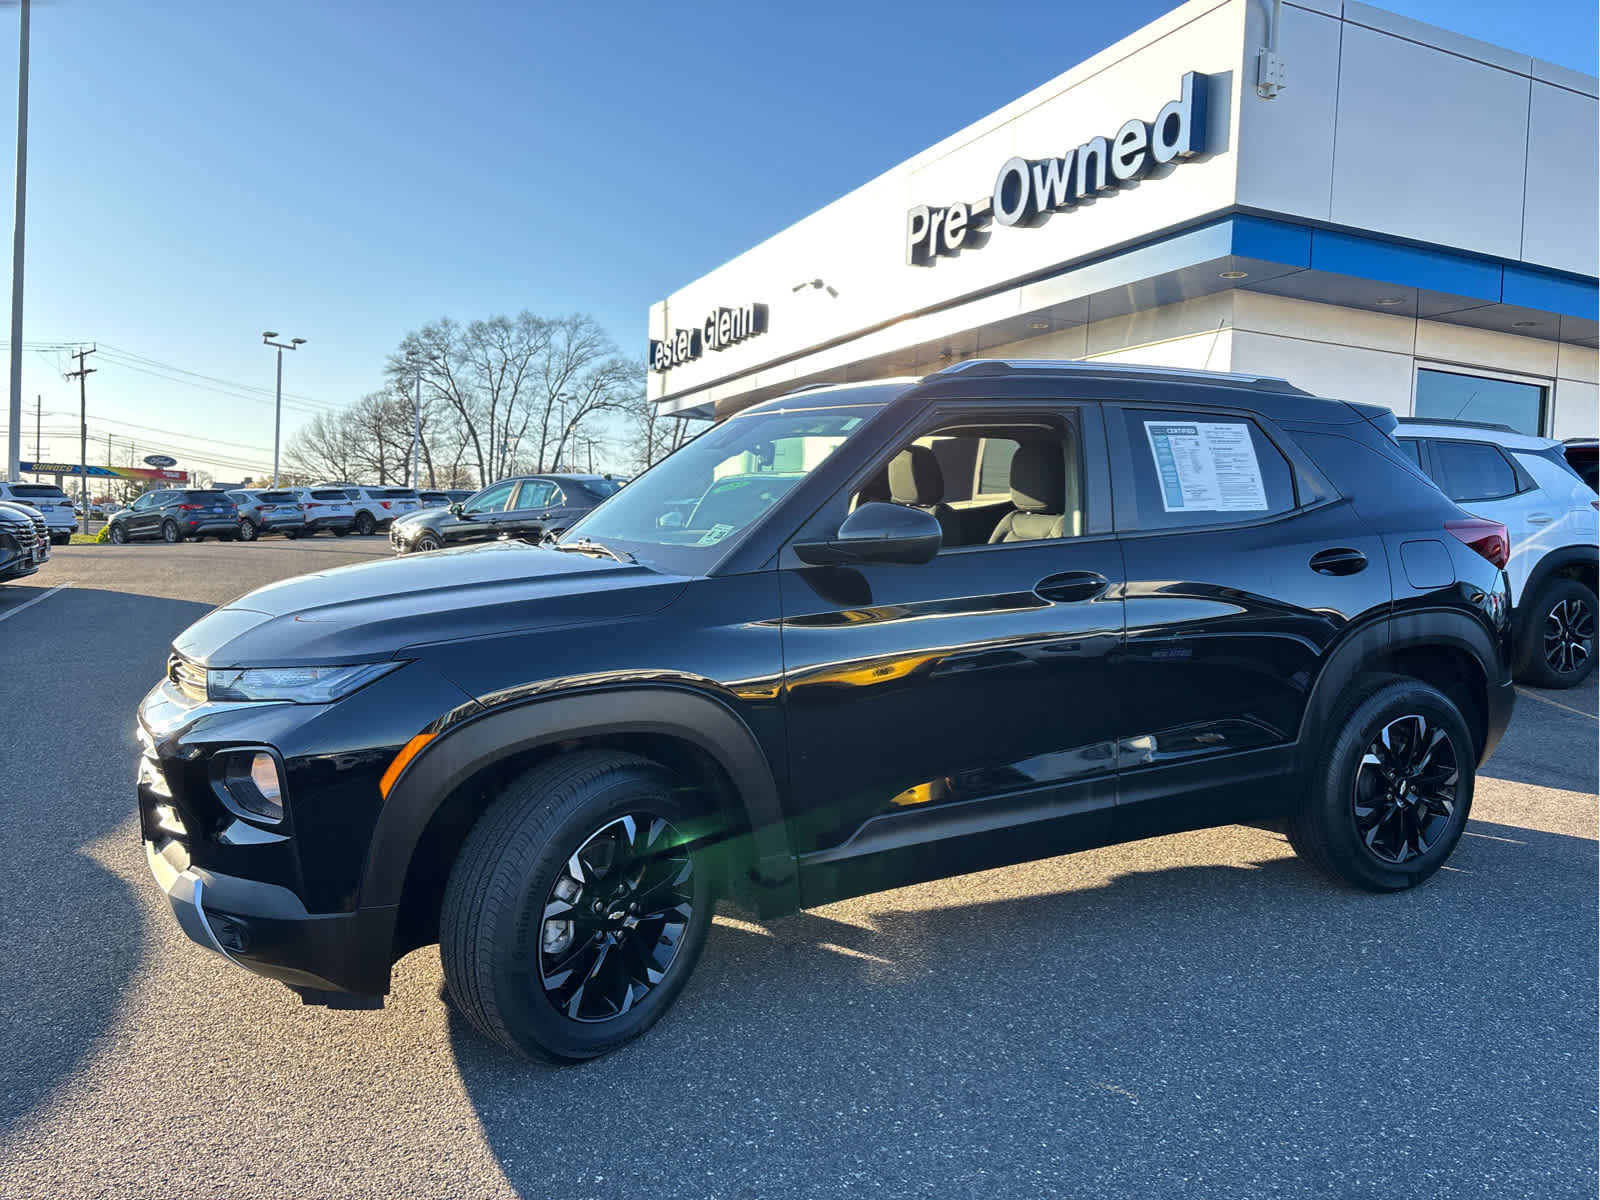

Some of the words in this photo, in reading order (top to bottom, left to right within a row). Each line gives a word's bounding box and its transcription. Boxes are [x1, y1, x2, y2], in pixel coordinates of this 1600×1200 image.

[906, 70, 1202, 266] Pre-Owned
[701, 303, 760, 350] Glenn
[31, 463, 73, 473] SUNOCO
